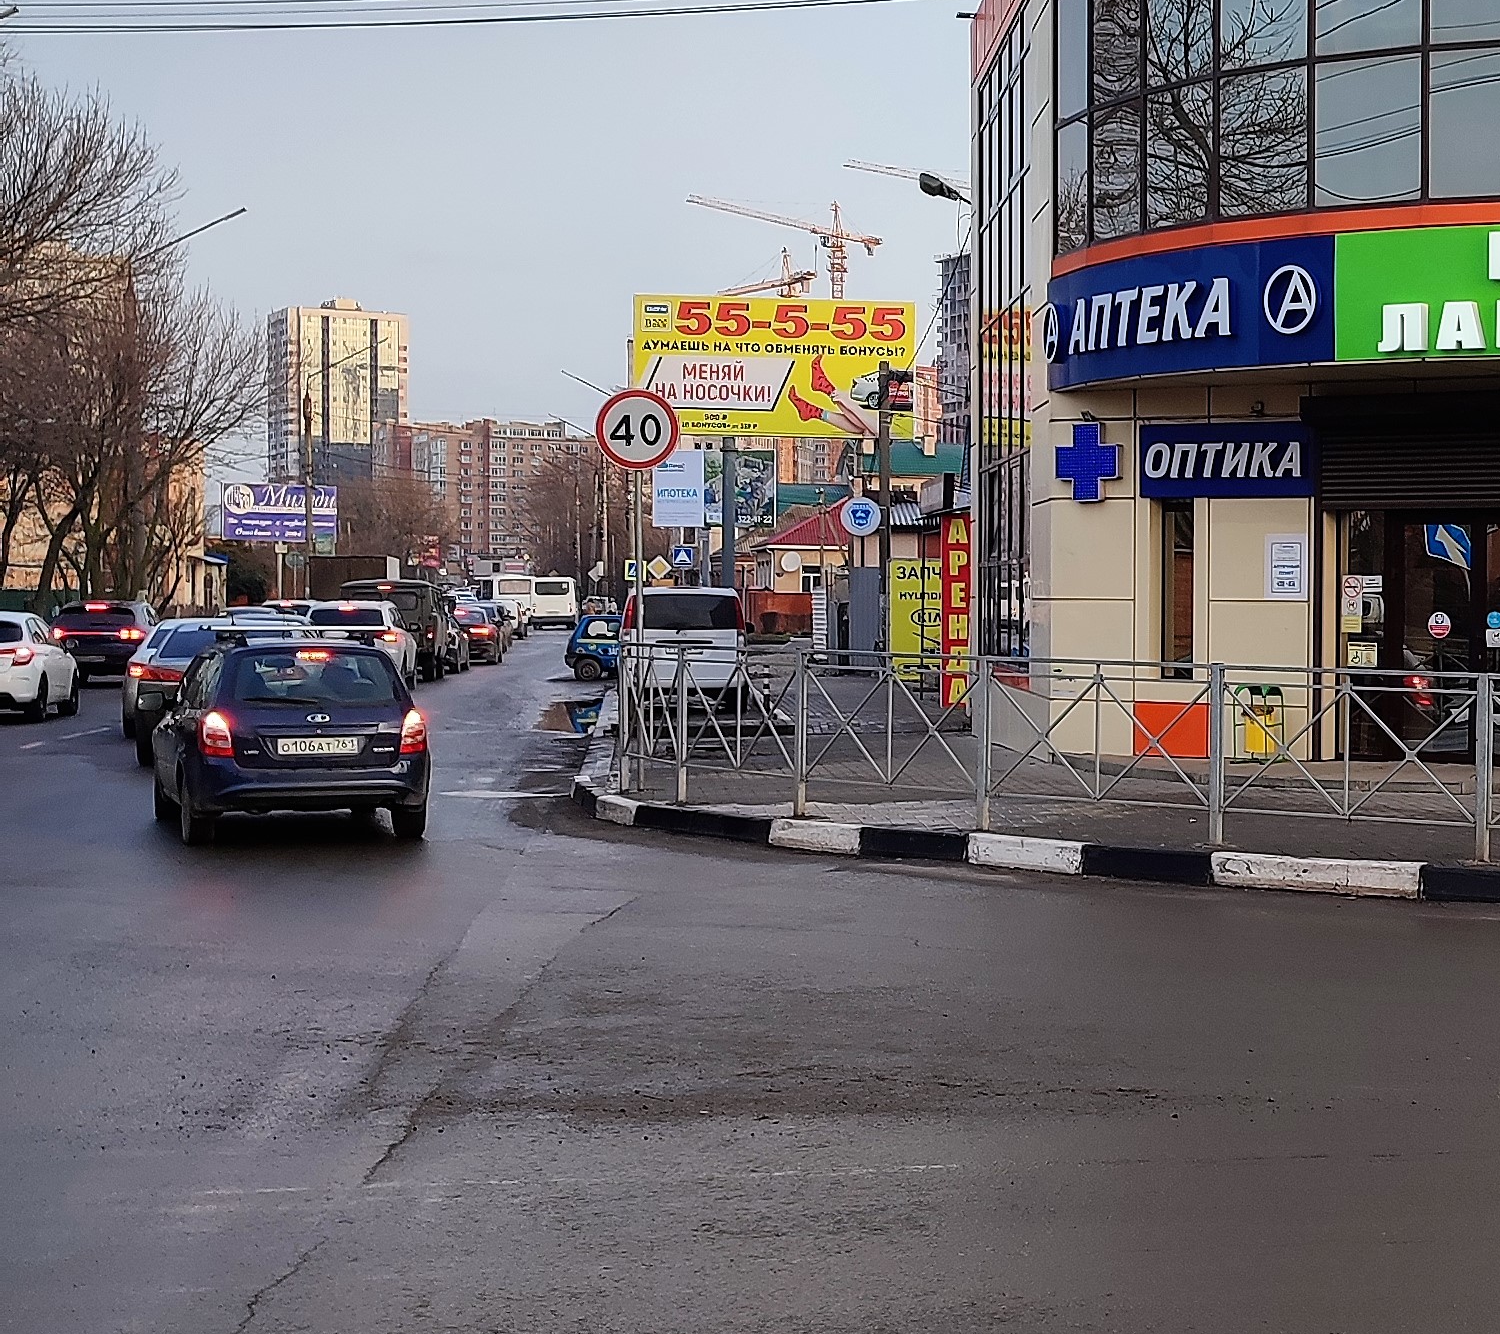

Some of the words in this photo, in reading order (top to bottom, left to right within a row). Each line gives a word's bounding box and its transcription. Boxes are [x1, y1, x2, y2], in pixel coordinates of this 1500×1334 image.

[674, 301, 905, 341] 55-5-55
[1068, 277, 1231, 355] АПТЕКА
[642, 339, 709, 352] ДУМАЕШЬ
[714, 342, 732, 352] НА
[736, 342, 761, 353] ЧТО
[764, 343, 835, 355] ОБМЕНЯТЬ
[682, 360, 744, 382] МЕНЯЙ
[655, 382, 678, 400] НА
[683, 383, 772, 403] НОСОЧКИ!
[609, 413, 662, 447] 40
[1144, 441, 1302, 478] ОПТИКА
[656, 488, 698, 498] ИПОТЕКА
[945, 518, 969, 704] АРЕНДА
